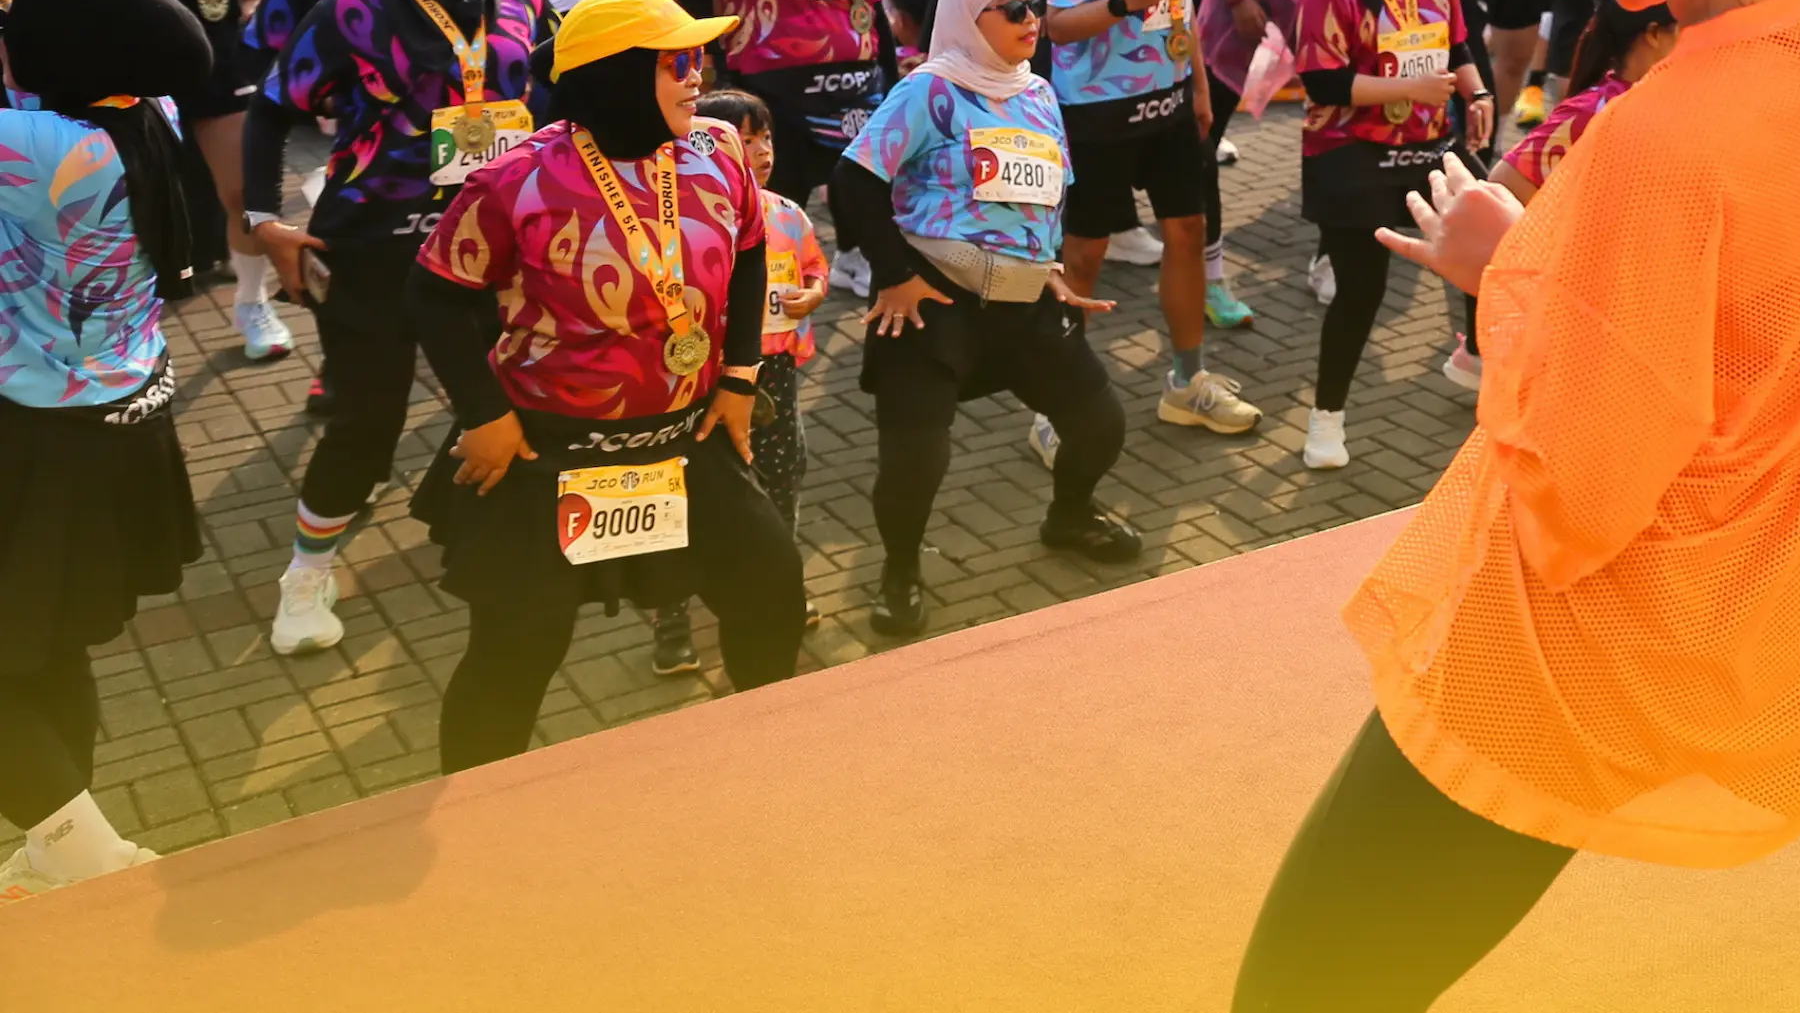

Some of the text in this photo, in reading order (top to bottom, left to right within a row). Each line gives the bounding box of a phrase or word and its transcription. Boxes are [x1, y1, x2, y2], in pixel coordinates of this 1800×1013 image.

[437, 143, 449, 166] F
[980, 160, 991, 181] F
[1001, 161, 1045, 188] 4280
[582, 142, 638, 235] FINISHER 5K
[661, 170, 676, 230] JCORUN
[586, 470, 665, 490] JCO RUN
[668, 477, 683, 493] 5K
[567, 512, 582, 538] F
[592, 503, 657, 540] 9006
